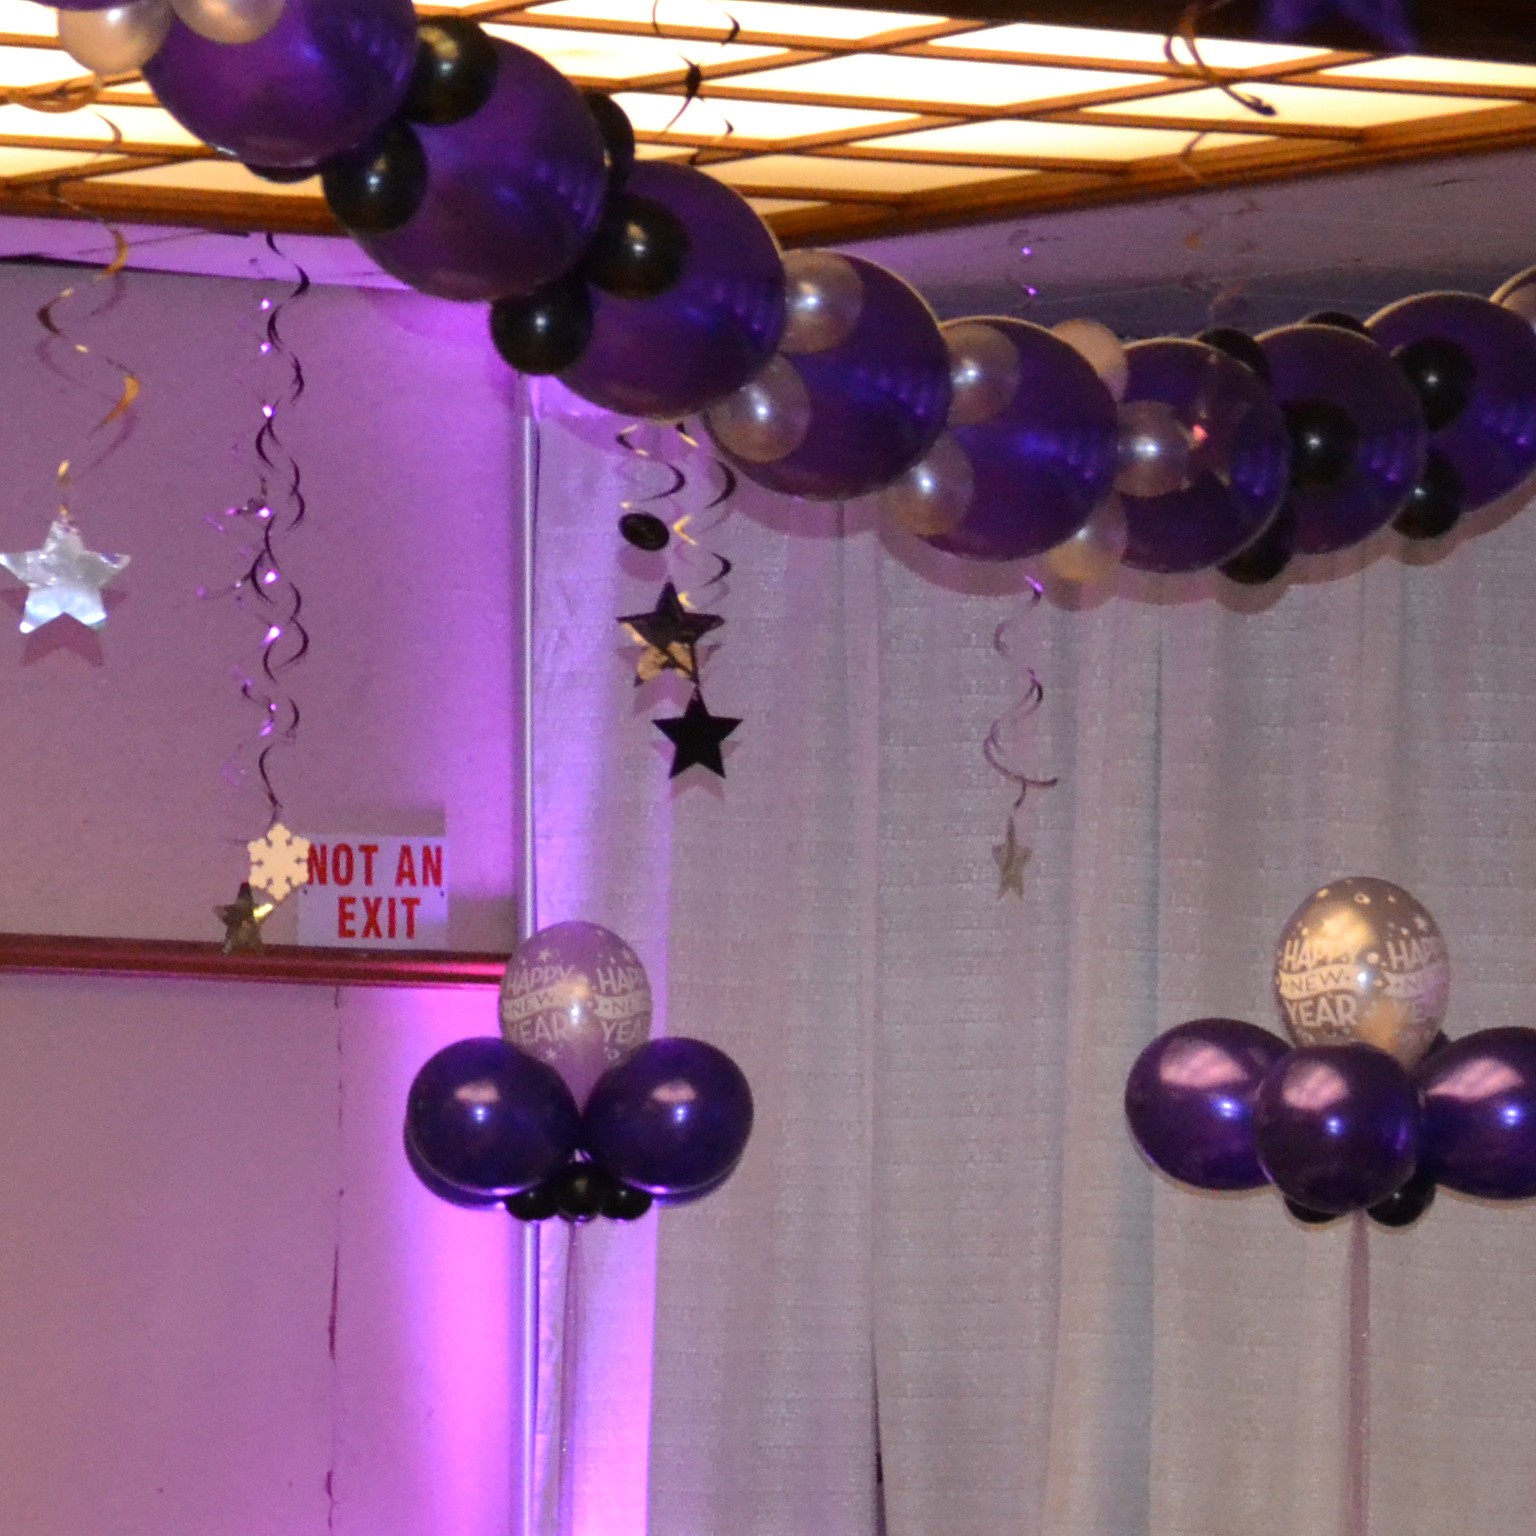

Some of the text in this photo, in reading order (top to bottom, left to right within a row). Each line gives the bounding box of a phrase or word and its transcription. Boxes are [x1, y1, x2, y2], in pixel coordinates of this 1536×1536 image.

[306, 843, 443, 887] NOT AN
[337, 896, 421, 939] EXIT
[1290, 968, 1344, 993] NEW
[1284, 993, 1358, 1028] YEAR
